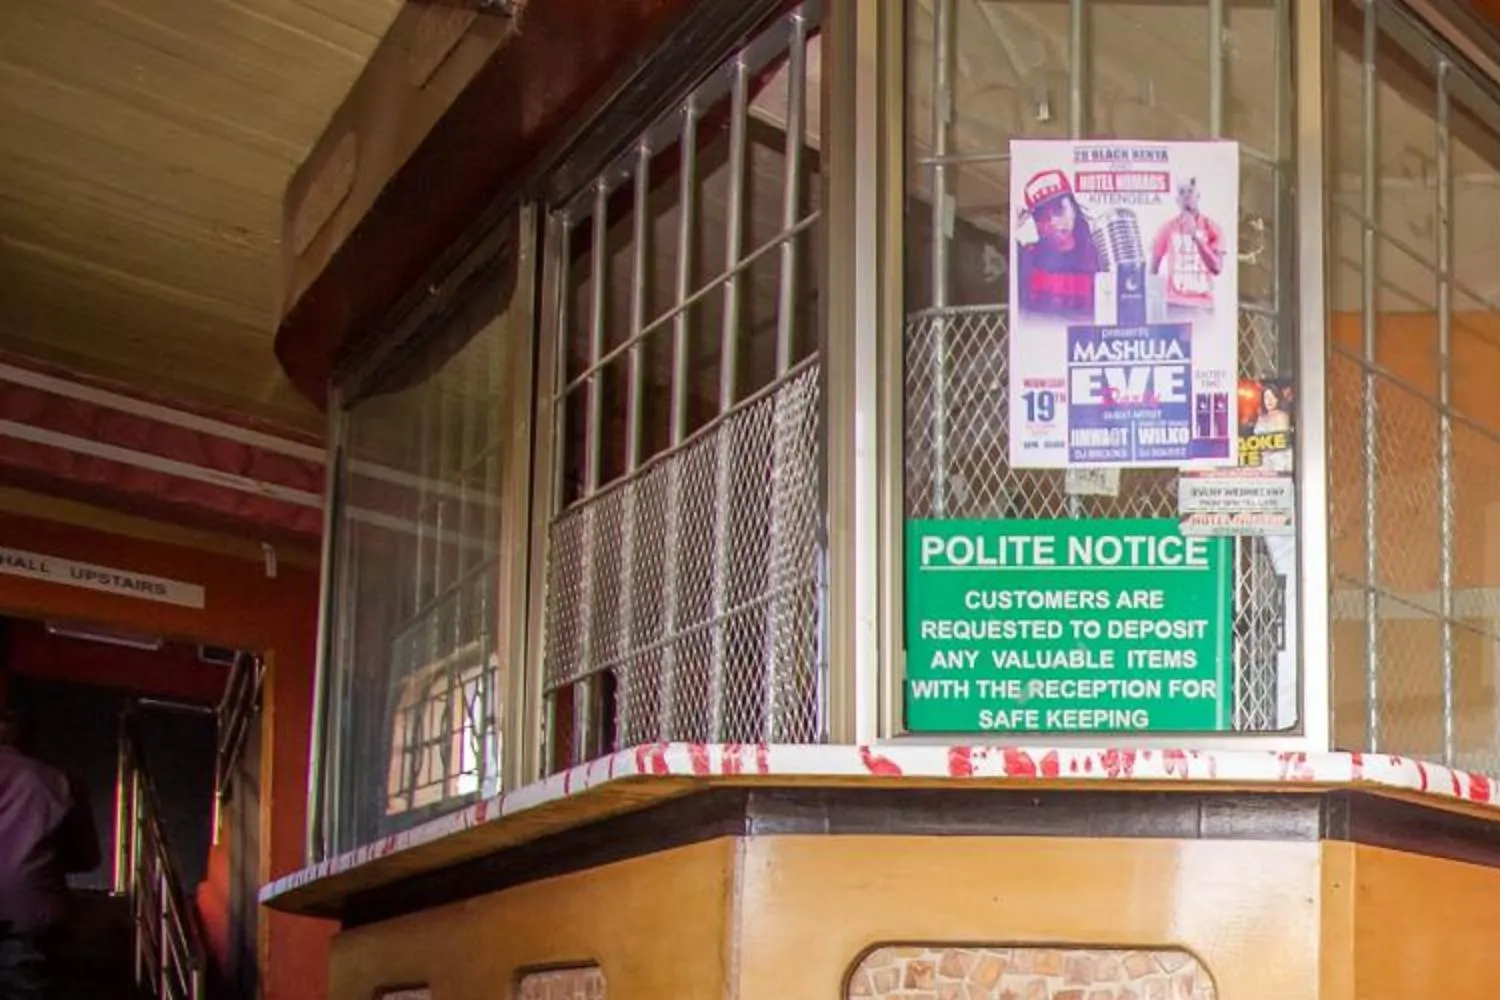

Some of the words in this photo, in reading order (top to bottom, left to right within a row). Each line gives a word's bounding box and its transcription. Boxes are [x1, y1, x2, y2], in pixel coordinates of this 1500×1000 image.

[1073, 339, 1184, 361] MASHUJA
[1071, 366, 1187, 405] EVE
[920, 535, 1056, 566] POLITE
[1068, 535, 1209, 567] NOTICE
[70, 567, 168, 595] UPSTAIRS
[964, 590, 1110, 610] CUSTOMERS
[1115, 590, 1164, 610] ARE
[920, 620, 1063, 641] REQUESTED
[1070, 619, 1099, 639] TO
[1107, 619, 1208, 640] DEPOSIT
[930, 650, 979, 669] ANY
[992, 650, 1114, 669] VALUABLE
[1127, 650, 1197, 669] ITEMS
[911, 680, 969, 699] WITH
[975, 680, 1021, 699] THE
[1027, 680, 1162, 699] RECEPTION
[1169, 680, 1217, 699] FOR
[978, 709, 1039, 729] SAFE
[1046, 709, 1149, 729] KEEPING
